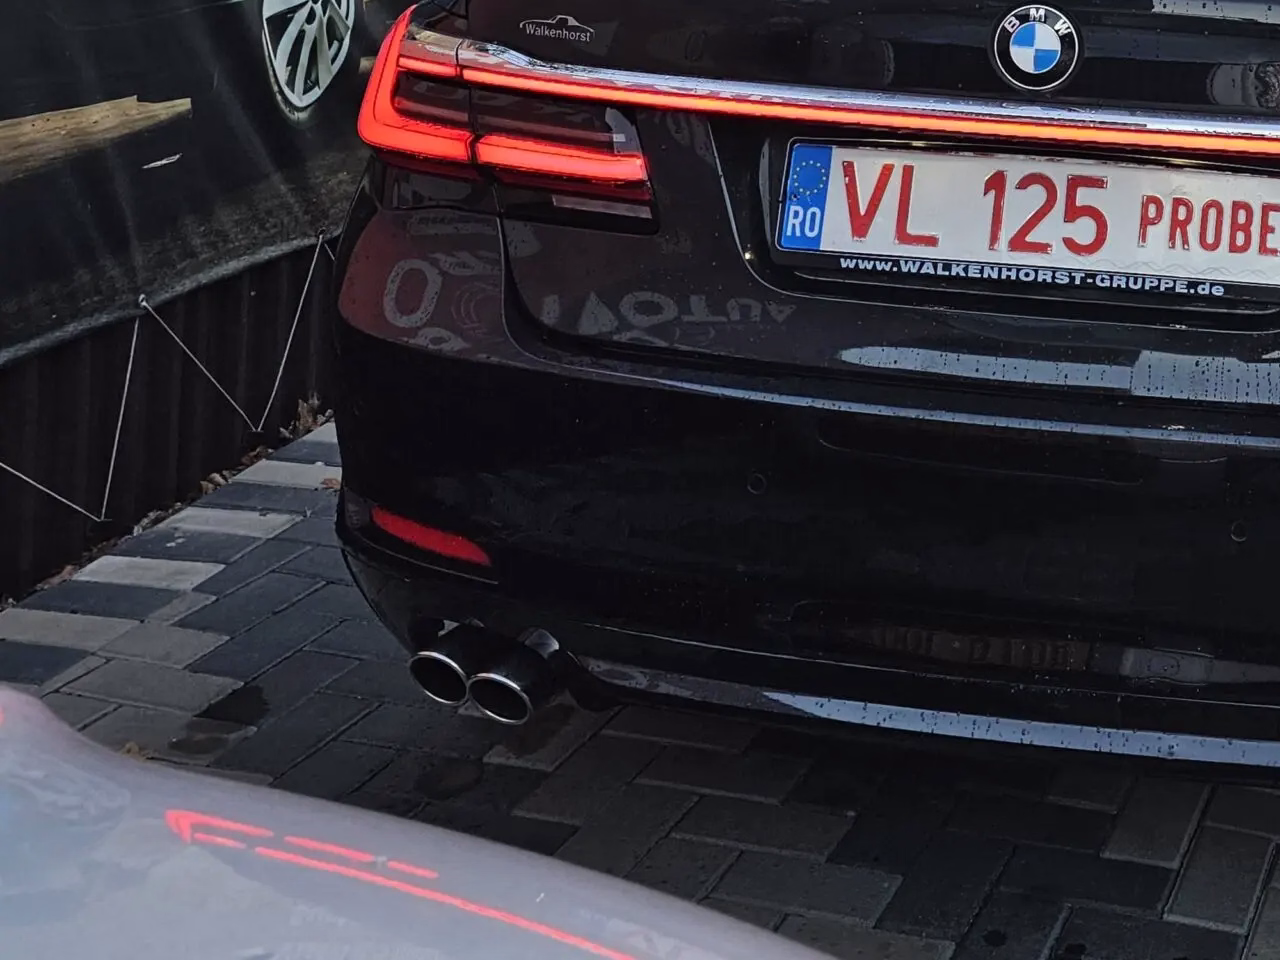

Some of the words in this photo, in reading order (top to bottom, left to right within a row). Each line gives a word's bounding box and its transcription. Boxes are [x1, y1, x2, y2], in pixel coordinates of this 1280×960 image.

[525, 23, 591, 42] Walkenhorst
[1004, 7, 1072, 37] BMW
[786, 204, 822, 238] RO
[842, 160, 940, 248] VL
[983, 169, 1109, 257] 125
[840, 257, 1225, 296] www.WALKENHORST-GRUPPE.de
